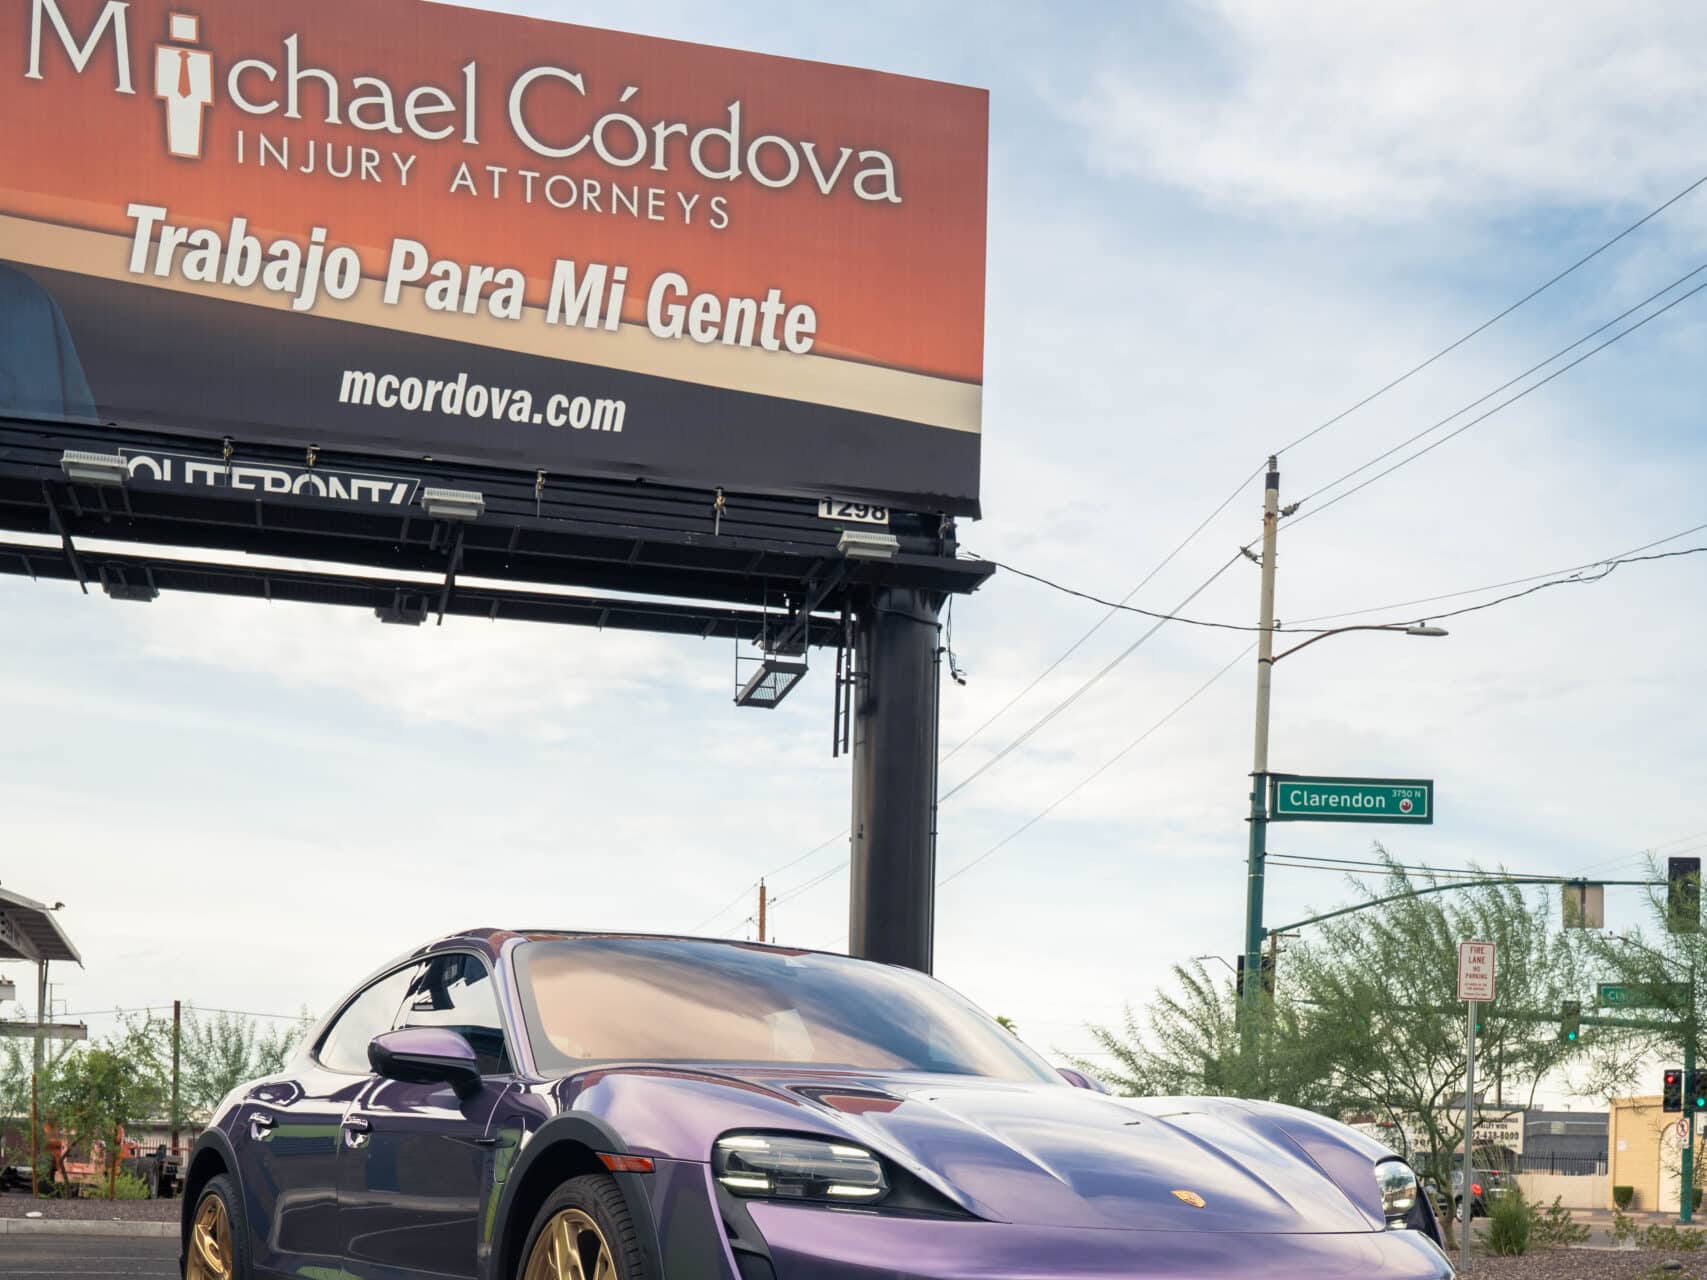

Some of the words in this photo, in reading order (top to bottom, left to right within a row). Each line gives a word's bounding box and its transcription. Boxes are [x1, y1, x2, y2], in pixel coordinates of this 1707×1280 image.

[508, 65, 903, 204] Córdova
[236, 130, 417, 187] INJURY
[449, 162, 730, 231] ATTORNEYS
[126, 203, 362, 312] Trabajo
[382, 238, 526, 321] Para
[545, 258, 629, 332] Mi
[646, 271, 817, 355] Gente
[338, 369, 627, 433] mcordova.com
[1290, 790, 1385, 808] Clarendon
[1392, 789, 1412, 798] 3750
[1414, 789, 1422, 798] N
[1468, 956, 1486, 964] LANE
